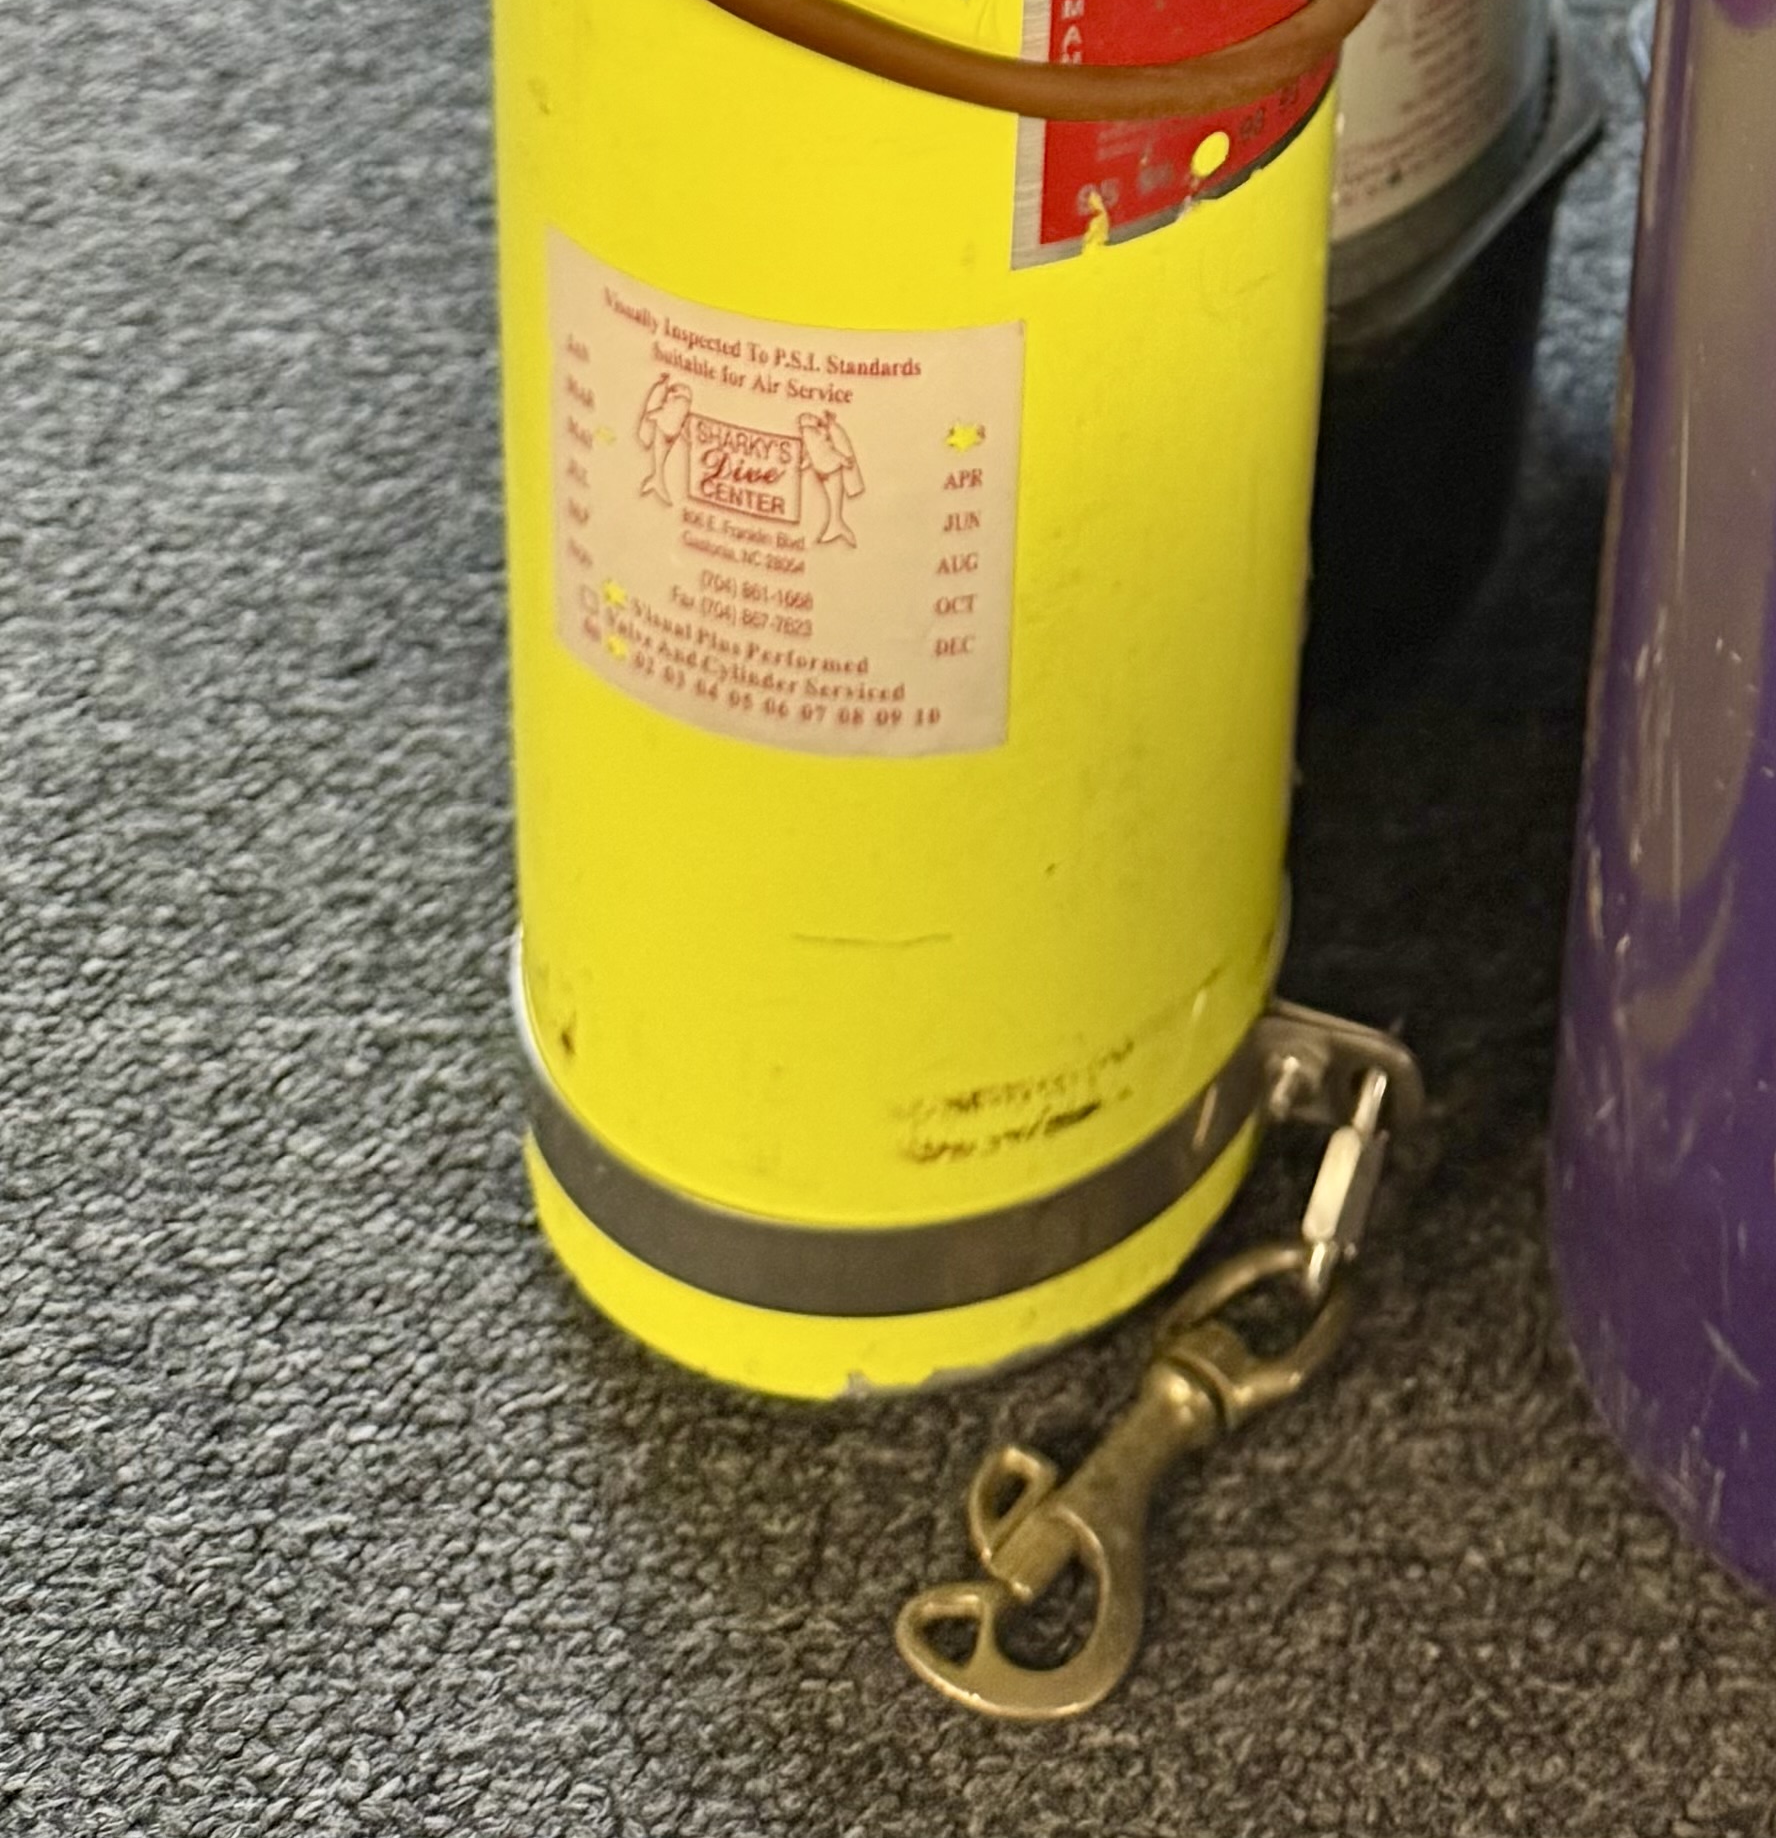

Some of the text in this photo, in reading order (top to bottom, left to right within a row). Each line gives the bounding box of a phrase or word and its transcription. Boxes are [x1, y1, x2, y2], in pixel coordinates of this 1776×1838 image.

[664, 318, 741, 358] Inspected
[748, 342, 768, 364] To
[827, 355, 921, 376] Standards
[653, 342, 853, 403] Suitable for Air Service
[698, 421, 792, 464] SHARKY'S
[701, 448, 786, 484] Dive
[944, 469, 983, 490] APR
[701, 482, 785, 515] CENTER
[943, 511, 981, 532] JUN
[936, 553, 978, 575] AUG
[701, 570, 737, 599] (704)
[702, 597, 737, 627] (704)
[933, 594, 977, 616] OCT
[747, 641, 869, 674] Performed
[934, 636, 976, 658] DEC
[703, 655, 797, 694] Cylinder
[804, 678, 905, 702] Serviced
[695, 678, 719, 701] 04
[728, 688, 754, 711] 05
[764, 696, 789, 719] 06
[802, 703, 827, 723] 07
[838, 707, 865, 726] 08
[876, 707, 903, 727] 09
[915, 707, 942, 726] 10
